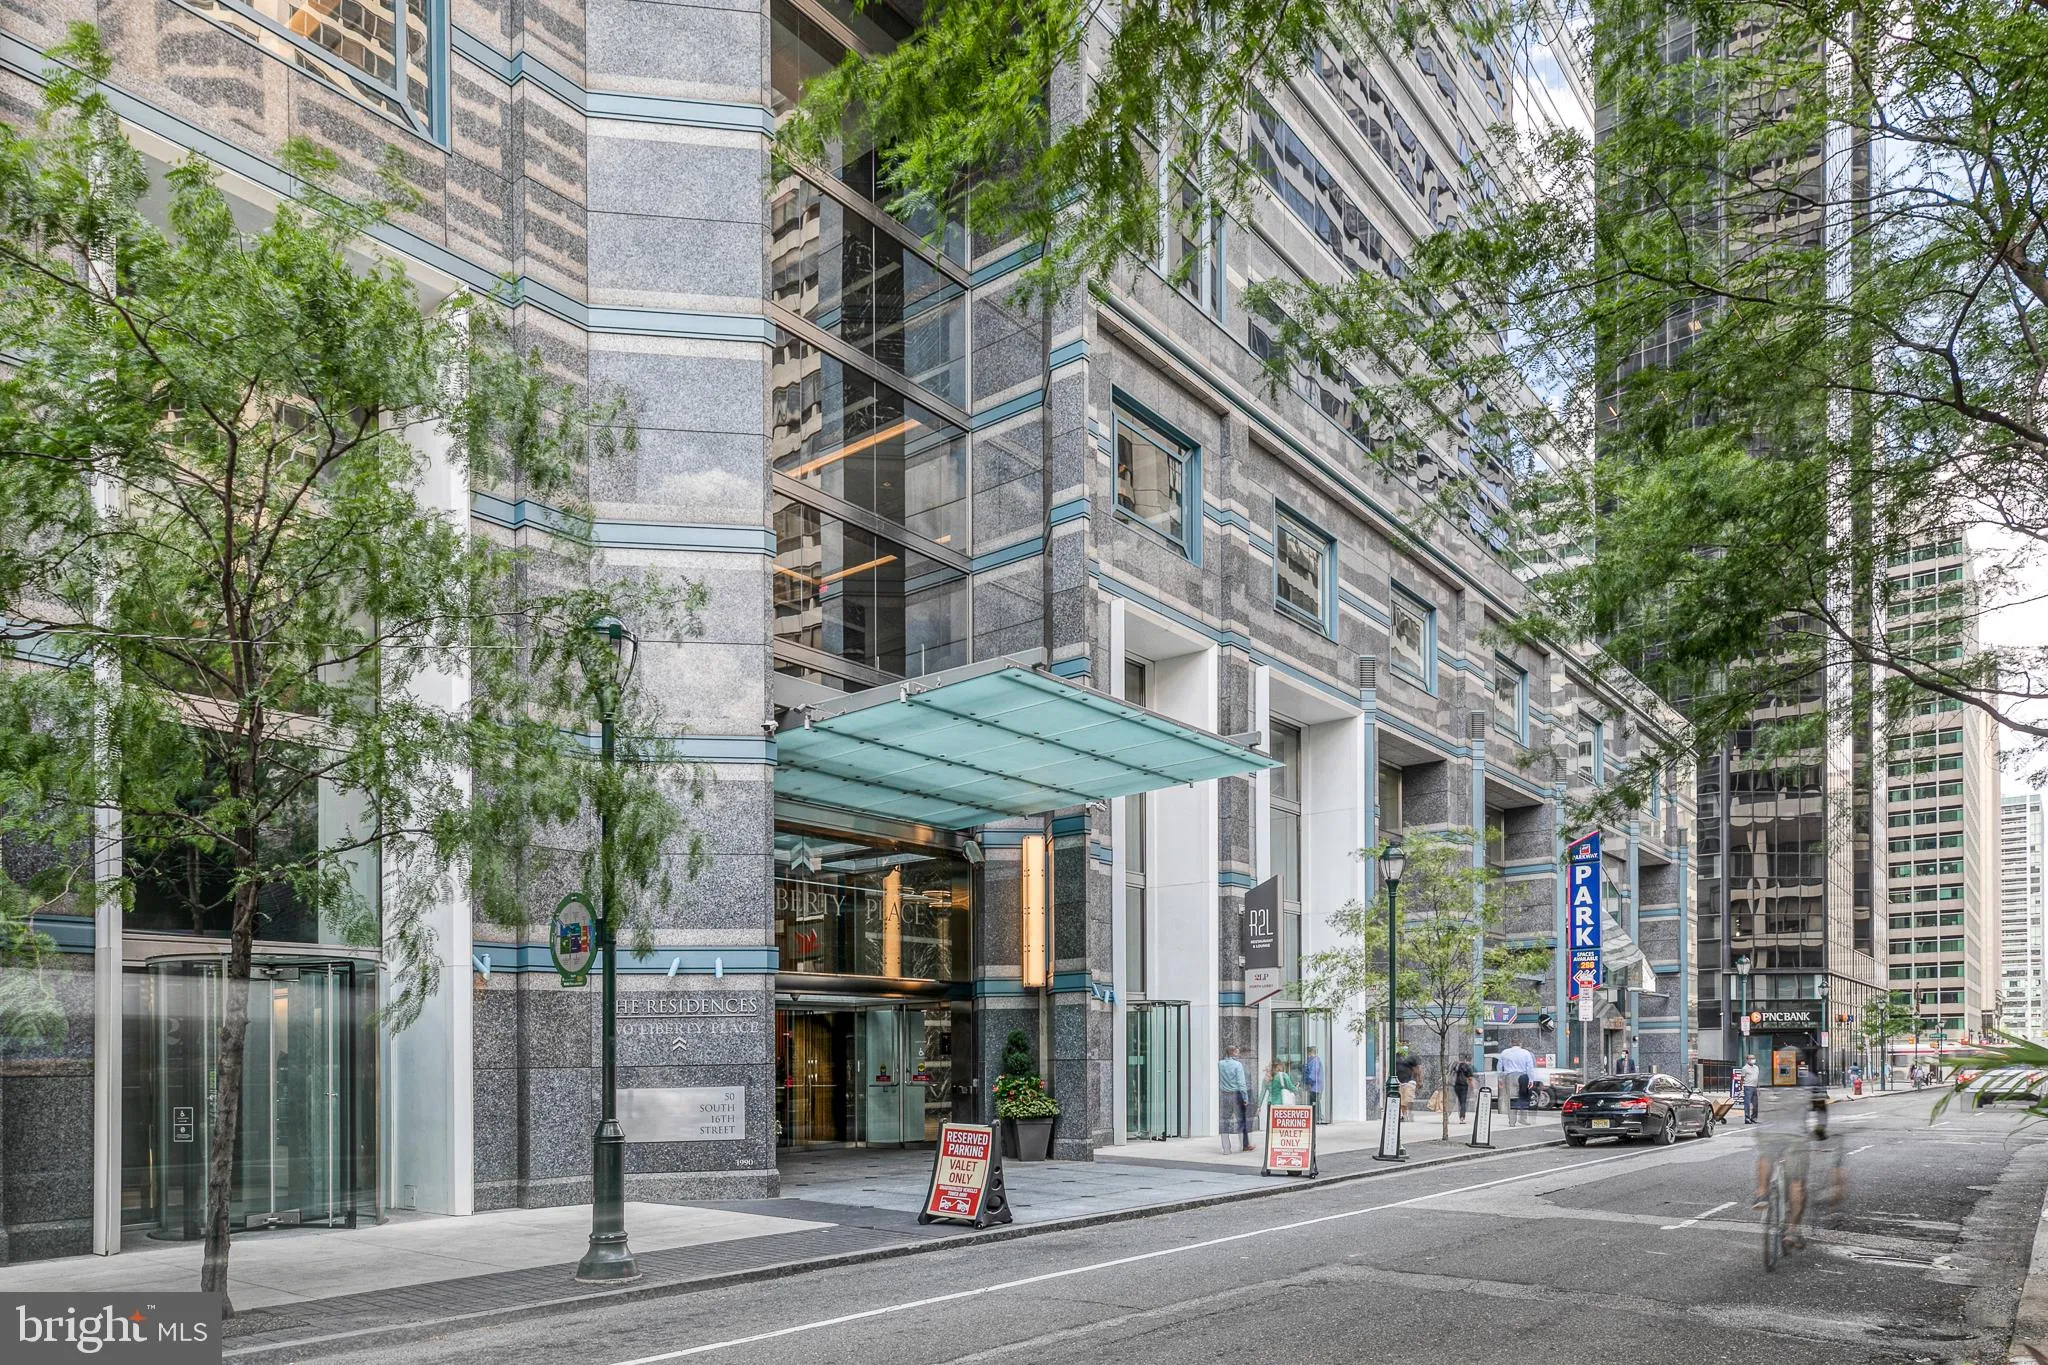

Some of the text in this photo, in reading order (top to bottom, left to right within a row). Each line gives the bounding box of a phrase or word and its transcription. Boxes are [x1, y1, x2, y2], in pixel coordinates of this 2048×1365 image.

[775, 887, 926, 926] BERTY PLACE
[1573, 865, 1595, 947] PARK
[1248, 908, 1274, 937] R2L
[615, 998, 758, 1014] HE RESIDENCES
[640, 1022, 703, 1035] LIBERTY
[711, 1021, 760, 1034] PLACE
[724, 1093, 735, 1101] 50
[700, 1104, 735, 1112] SOUTH
[711, 1115, 735, 1123] 16TH
[1274, 1110, 1309, 1119] RESERVED
[1276, 1119, 1306, 1128] PARKING
[700, 1126, 736, 1134] STREET
[1279, 1129, 1303, 1138] VALET
[947, 1131, 989, 1146] RESERVED
[1280, 1139, 1301, 1147] ONLY
[948, 1143, 984, 1157] PARKING
[735, 1159, 754, 1167] 1990
[949, 1159, 978, 1172] VALET
[948, 1172, 973, 1184] ONLY
